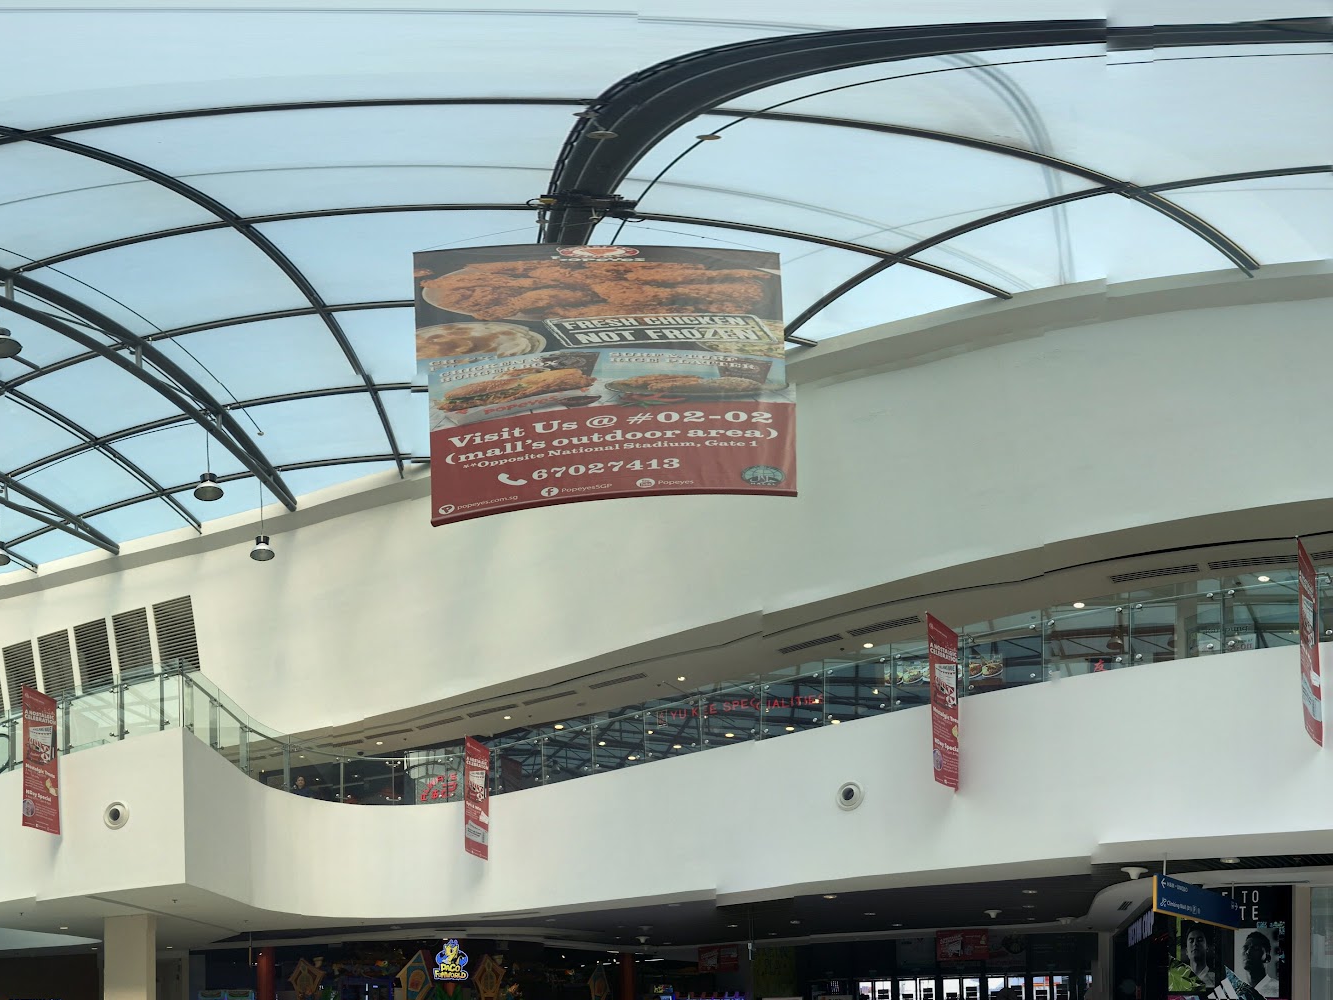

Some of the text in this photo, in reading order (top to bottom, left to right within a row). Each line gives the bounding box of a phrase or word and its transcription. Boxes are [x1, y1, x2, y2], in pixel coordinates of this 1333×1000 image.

[561, 315, 746, 330] FRESH CHICKEN
[574, 327, 760, 344] NOT FROZEN
[448, 411, 773, 448] Visit Us @ #02-02
[552, 429, 681, 447] outdoor
[686, 427, 779, 440] area)
[548, 443, 620, 457] National
[623, 440, 701, 449] Stadium,
[704, 439, 746, 447] Gate
[532, 457, 681, 481] 67027413
[457, 494, 519, 511] popeyes.com.sg
[670, 709, 687, 720] YU
[1242, 890, 1260, 903] TO
